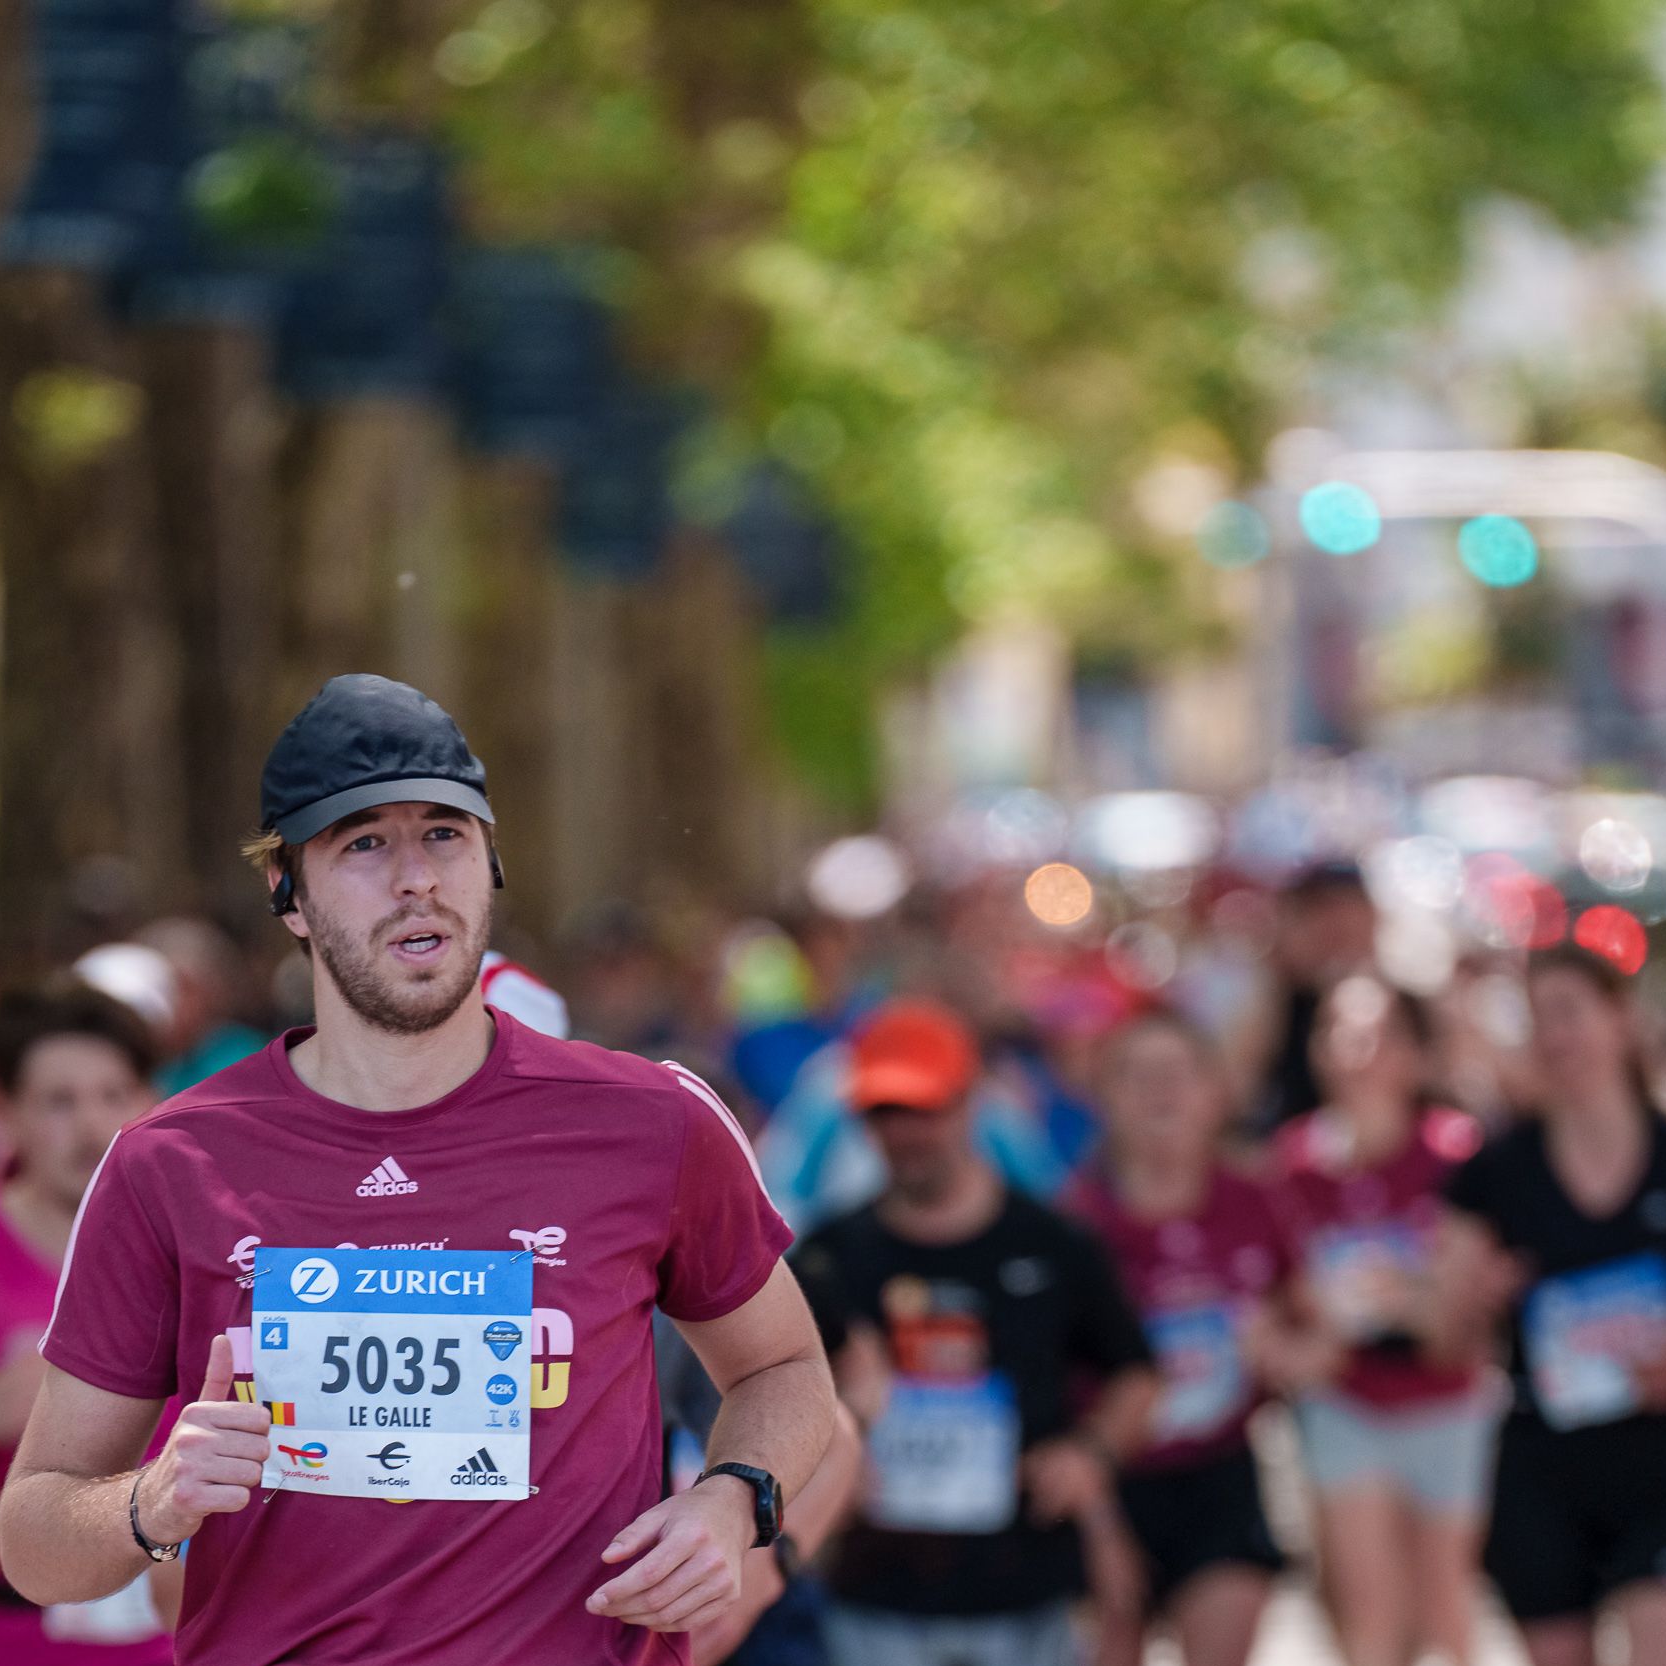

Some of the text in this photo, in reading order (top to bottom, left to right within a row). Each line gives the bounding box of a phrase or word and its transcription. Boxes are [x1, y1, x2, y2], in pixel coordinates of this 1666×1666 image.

[356, 1181, 418, 1197] adidas
[354, 1269, 486, 1296] ZURICH
[264, 1327, 282, 1346] 4
[320, 1335, 461, 1396] 5035
[486, 1384, 514, 1395] 42K
[349, 1406, 432, 1428] LE GALLE
[450, 1471, 508, 1487] adidas
